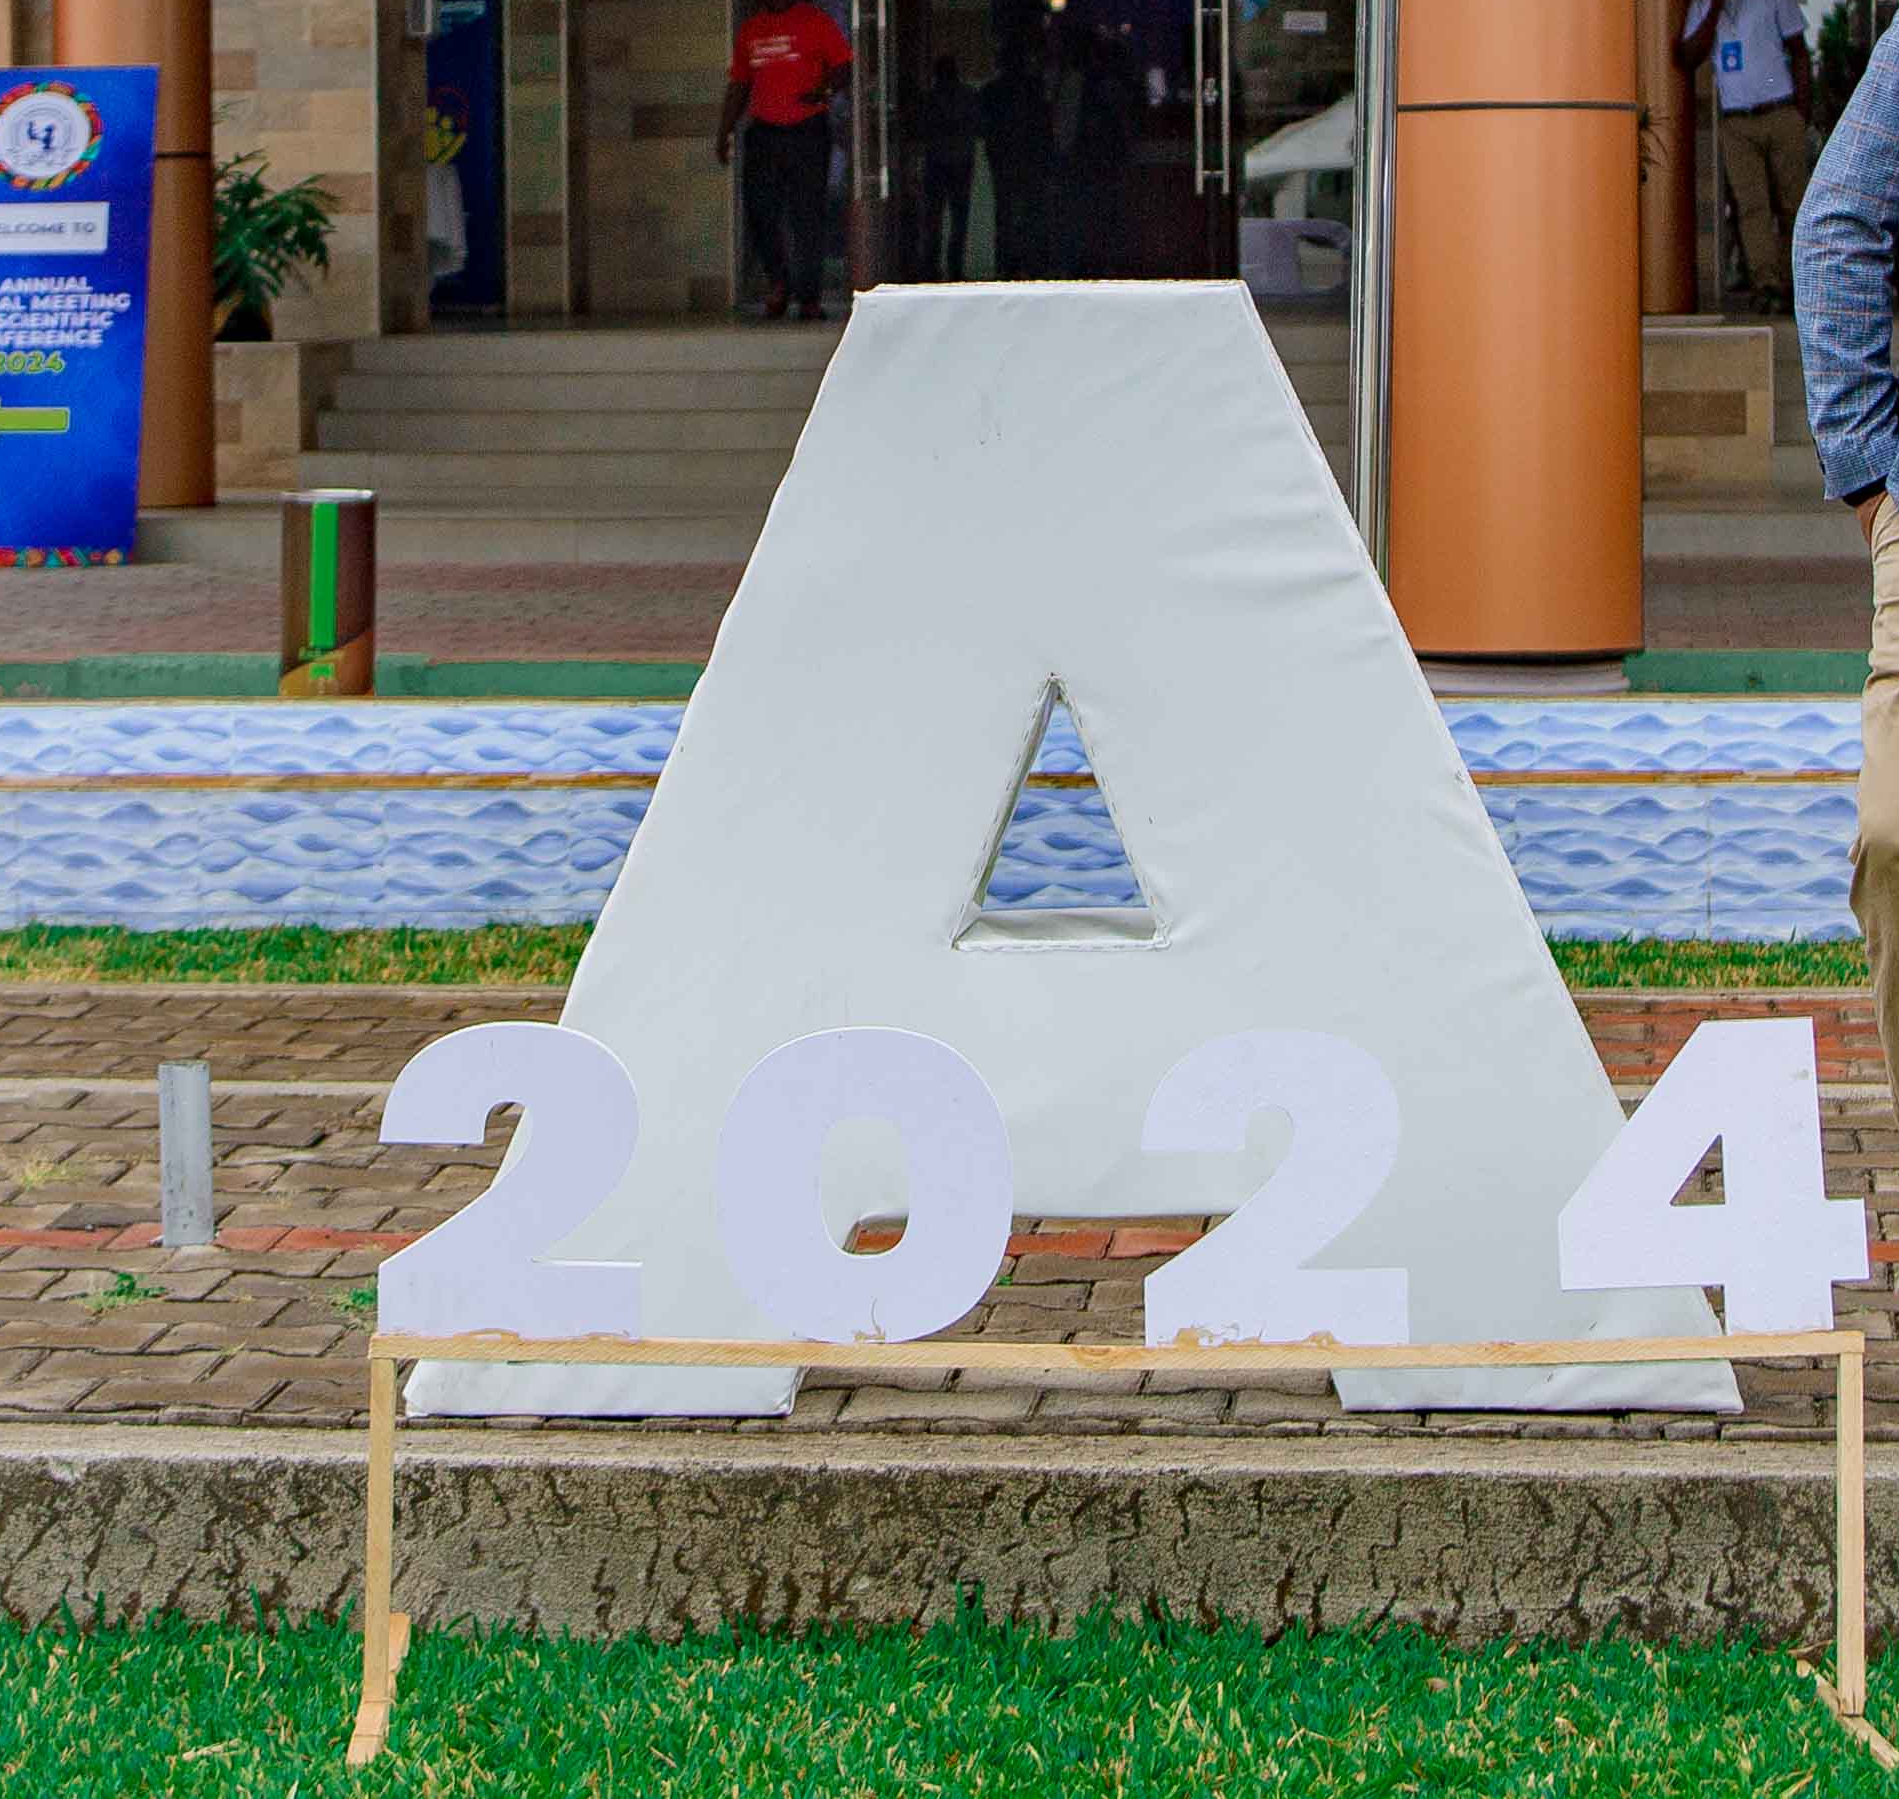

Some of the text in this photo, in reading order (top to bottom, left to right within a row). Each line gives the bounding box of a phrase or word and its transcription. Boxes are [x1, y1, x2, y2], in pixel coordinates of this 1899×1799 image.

[73, 221, 96, 234] TO
[29, 292, 131, 313] MEETING
[378, 1017, 1869, 1346] 2024
